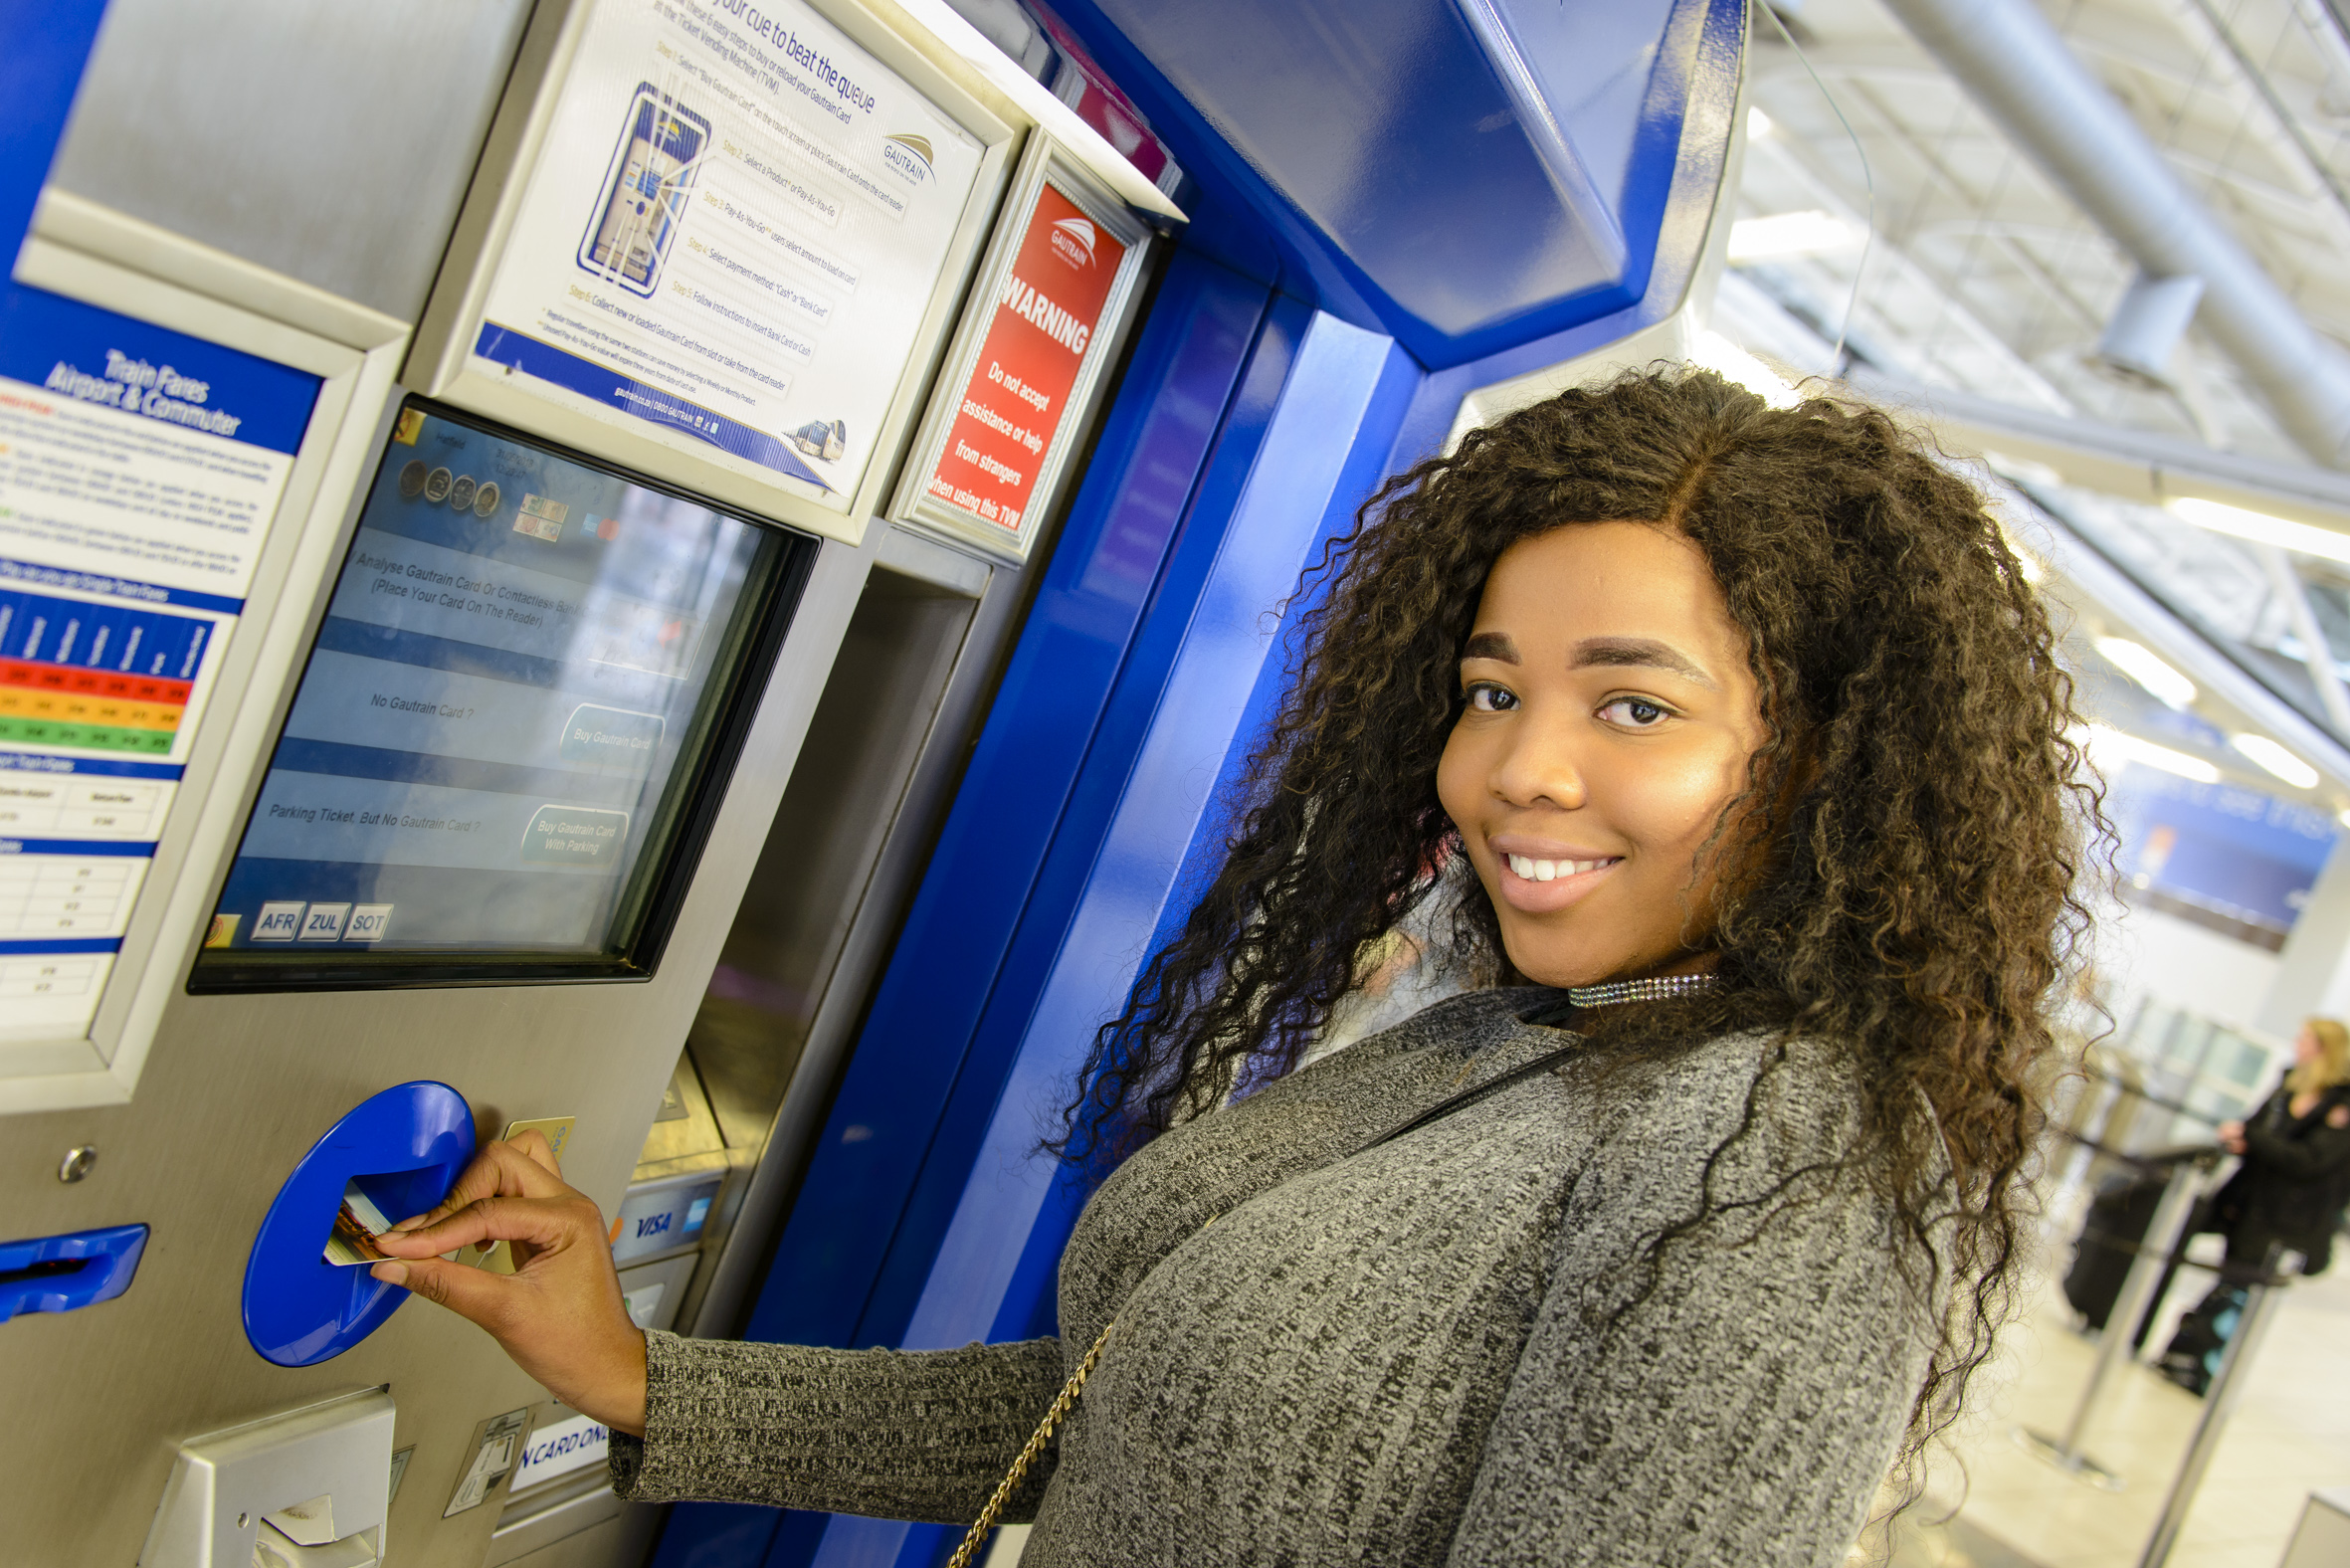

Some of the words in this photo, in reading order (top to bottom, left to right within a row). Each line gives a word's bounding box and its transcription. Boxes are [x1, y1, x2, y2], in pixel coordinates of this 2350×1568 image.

[675, 14, 701, 35] Ticket
[697, 32, 731, 60] Vending
[728, 50, 759, 77] Machine
[757, 70, 780, 95] (TVM).
[706, 13, 714, 26] 6
[711, 20, 730, 40] easy
[728, 30, 750, 53] steps
[747, 44, 757, 57] to
[755, 49, 770, 68] buy
[768, 60, 777, 72] or
[775, 62, 798, 86] reload
[795, 79, 811, 98] your
[809, 87, 838, 113] Gautrain
[836, 106, 851, 124] Card
[713, 0, 742, 24] our
[746, 8, 771, 37] cue
[771, 23, 787, 48] to
[786, 32, 818, 71] beat
[816, 56, 839, 87] the
[836, 76, 874, 115] queue
[678, 55, 699, 76] Select
[712, 78, 740, 103] Gautrain
[753, 108, 763, 119] on
[761, 111, 773, 125] the
[771, 118, 789, 136] touch
[787, 130, 805, 148] screen
[804, 142, 811, 152] or
[809, 146, 825, 162] place
[825, 154, 848, 173] Gautrain
[847, 168, 859, 182] Card
[858, 177, 871, 191] onto
[870, 183, 879, 195] the
[877, 189, 889, 202] card
[888, 195, 904, 213] reader
[721, 140, 738, 158] Step
[744, 153, 763, 172] Select
[761, 166, 766, 174] a
[790, 184, 797, 193] or
[797, 186, 834, 217] Pay-As-You-Go
[884, 145, 926, 182] GAUTRAIN
[703, 191, 719, 208] Step
[771, 231, 786, 246] users
[785, 238, 802, 254] select
[800, 247, 822, 265] amount
[820, 259, 828, 269] to
[826, 261, 839, 275] load
[837, 270, 845, 279] on
[844, 271, 856, 285] card
[1049, 228, 1089, 266] GAUTRAIN
[686, 236, 703, 253] Step
[708, 248, 727, 264] Select
[726, 259, 752, 281] payment
[752, 271, 776, 290] method:
[791, 295, 798, 303] or
[568, 285, 585, 301] Step
[591, 295, 614, 313] Collect
[613, 307, 628, 320] new
[627, 313, 635, 323] or
[634, 315, 657, 332] loaded
[655, 325, 681, 343] Gautrain
[679, 336, 694, 350] Card
[694, 342, 708, 355] from
[706, 348, 719, 361] slot
[717, 354, 724, 363] or
[723, 355, 737, 369] take
[737, 361, 750, 375] from
[748, 367, 759, 379] the
[757, 371, 769, 384] card
[768, 376, 786, 391] reader
[671, 281, 688, 297] Step
[692, 291, 713, 308] Follow
[712, 302, 746, 324] instructions
[744, 317, 752, 327] to
[752, 320, 768, 335] insert
[767, 327, 782, 340] Bank
[780, 335, 793, 348] Card
[792, 342, 798, 351] or
[798, 343, 811, 356] Cash
[1001, 274, 1089, 355] WARNING
[45, 361, 125, 407] Airport
[120, 384, 143, 412] &
[141, 389, 242, 437] Commuter
[104, 348, 158, 389] Train
[155, 365, 210, 403] Fares
[987, 361, 1006, 384] Do
[1002, 371, 1022, 394] not
[1017, 381, 1050, 415] accept
[614, 387, 651, 407] gautrain.co.za
[653, 401, 669, 414] 0800
[667, 407, 694, 423] GAUTRAIN
[961, 395, 1015, 437] assistance
[1011, 426, 1025, 444] or
[1020, 428, 1045, 457] help
[954, 438, 982, 465] from
[977, 452, 1023, 490] strangers
[951, 485, 982, 511] using
[979, 497, 1000, 520] this
[997, 505, 1021, 529] TVM
[356, 552, 405, 578] Analyse
[406, 564, 453, 585] Gautrain
[455, 575, 482, 595] Card
[482, 582, 497, 596] Or
[498, 587, 555, 611] Contactless
[556, 601, 581, 617] Bank
[371, 578, 409, 600] (Place
[412, 587, 437, 603] Your
[439, 593, 465, 609] Card
[467, 600, 482, 613] On
[485, 603, 503, 618] The
[505, 608, 544, 629] Reader)
[371, 693, 388, 707] No
[390, 697, 437, 715] Gautrain
[439, 704, 463, 720] Card
[467, 708, 474, 719] ?
[573, 728, 592, 744] Buy
[592, 731, 630, 747] Gautrain
[630, 736, 652, 750] Card
[269, 804, 316, 822] Parking
[320, 808, 356, 824] Ticket,
[360, 811, 381, 825] But
[382, 814, 399, 826] No
[400, 815, 446, 830] Gautrain
[446, 819, 471, 832] Card
[537, 820, 556, 835] Buy
[556, 821, 595, 836] Gautrain
[595, 825, 617, 838] Card
[544, 837, 566, 851] With
[566, 840, 599, 855] Parking
[261, 912, 296, 930] AFR
[309, 914, 340, 930] ZUL
[353, 914, 383, 930] SOT
[637, 1212, 673, 1238] VISA
[533, 1433, 579, 1465] CARD
[580, 1425, 608, 1448] ONL
